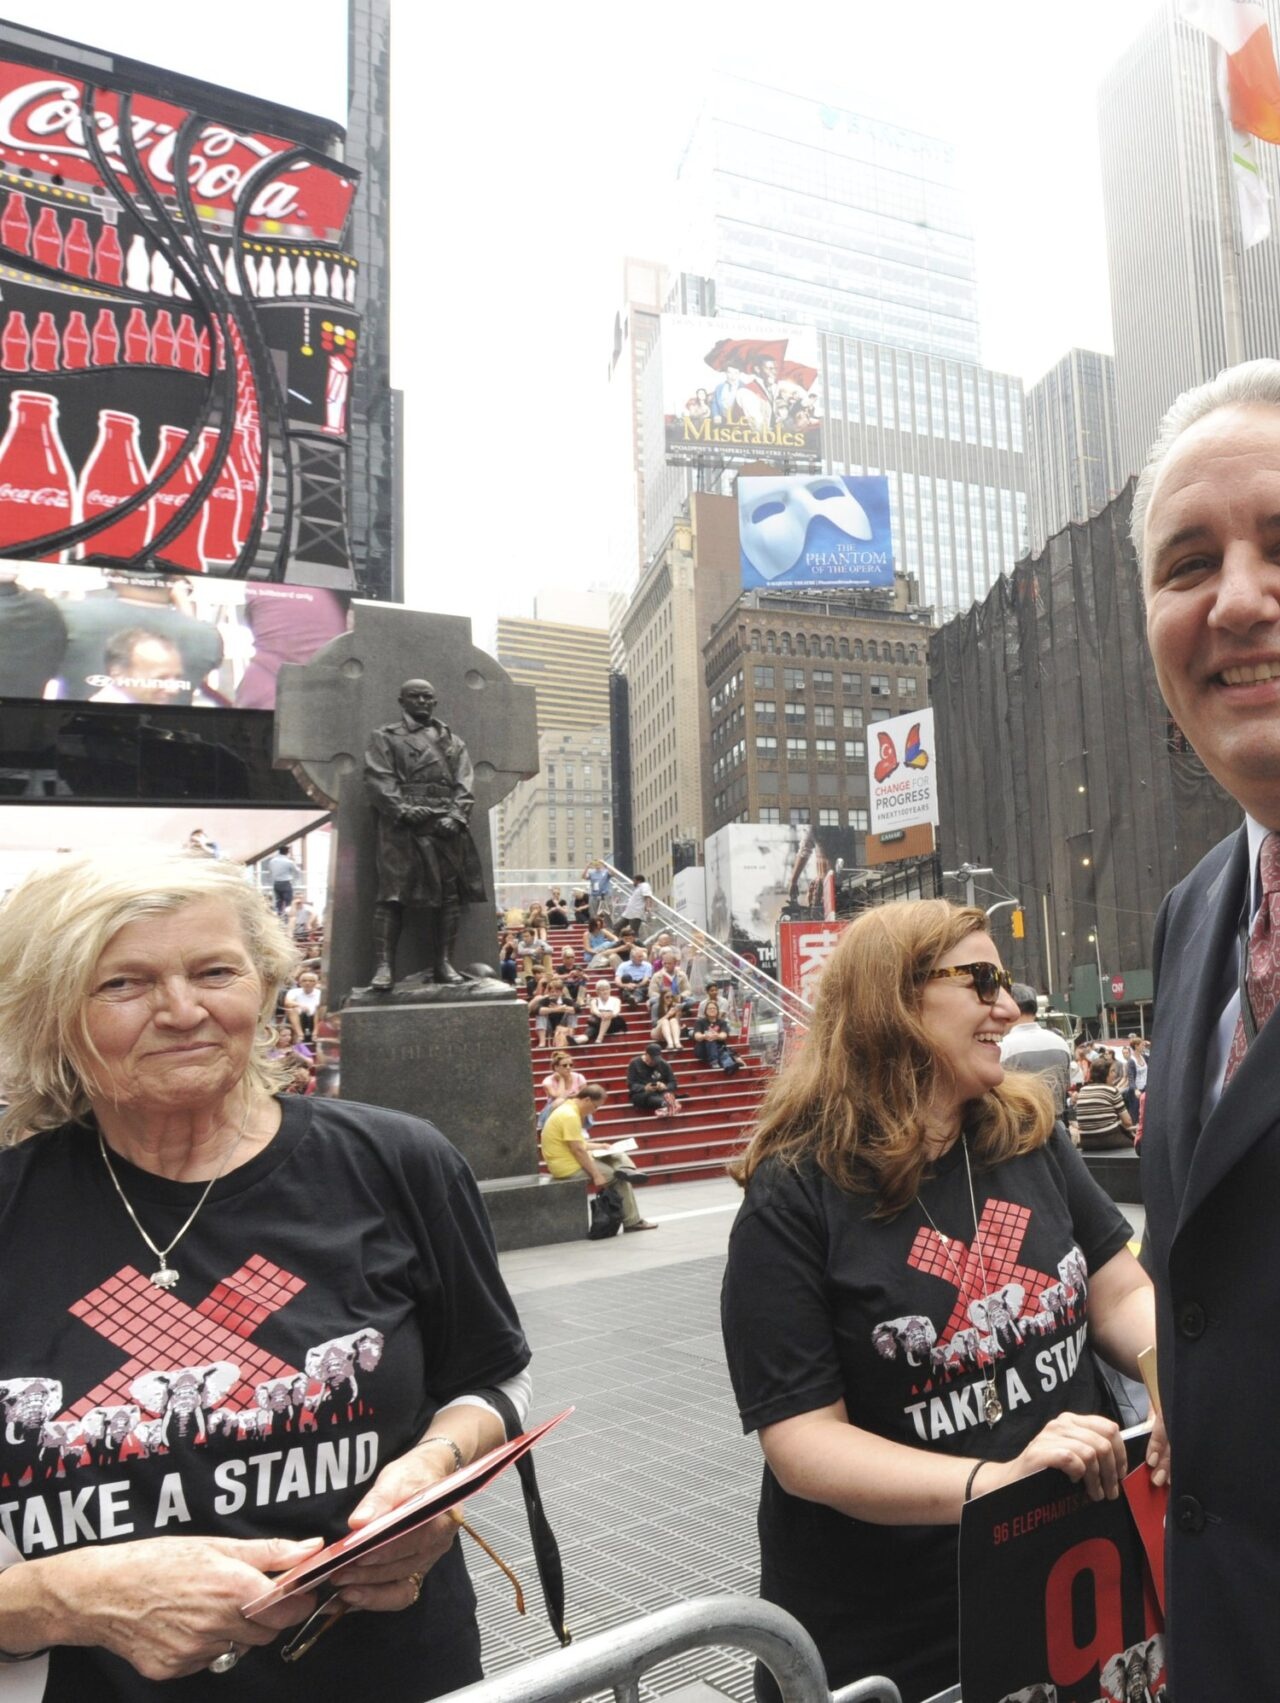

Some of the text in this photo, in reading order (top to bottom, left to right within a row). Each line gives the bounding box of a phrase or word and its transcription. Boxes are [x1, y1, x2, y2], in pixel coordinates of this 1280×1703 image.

[0, 79, 310, 219] Coca-Cola
[683, 415, 805, 447] Misérables
[806, 551, 887, 566] PHANTOM
[849, 564, 882, 574] OPERA
[875, 776, 929, 797] CHANGE FOR
[876, 788, 930, 810] PROGRESS
[877, 803, 930, 821] #NEXT100YEARS
[757, 947, 777, 961] TH
[904, 1321, 1088, 1441] TAKE A STAN
[0, 1431, 380, 1554] TAKE A STAND
[993, 1521, 1010, 1546] 96
[1013, 1496, 1078, 1538] ELEPHANTS
